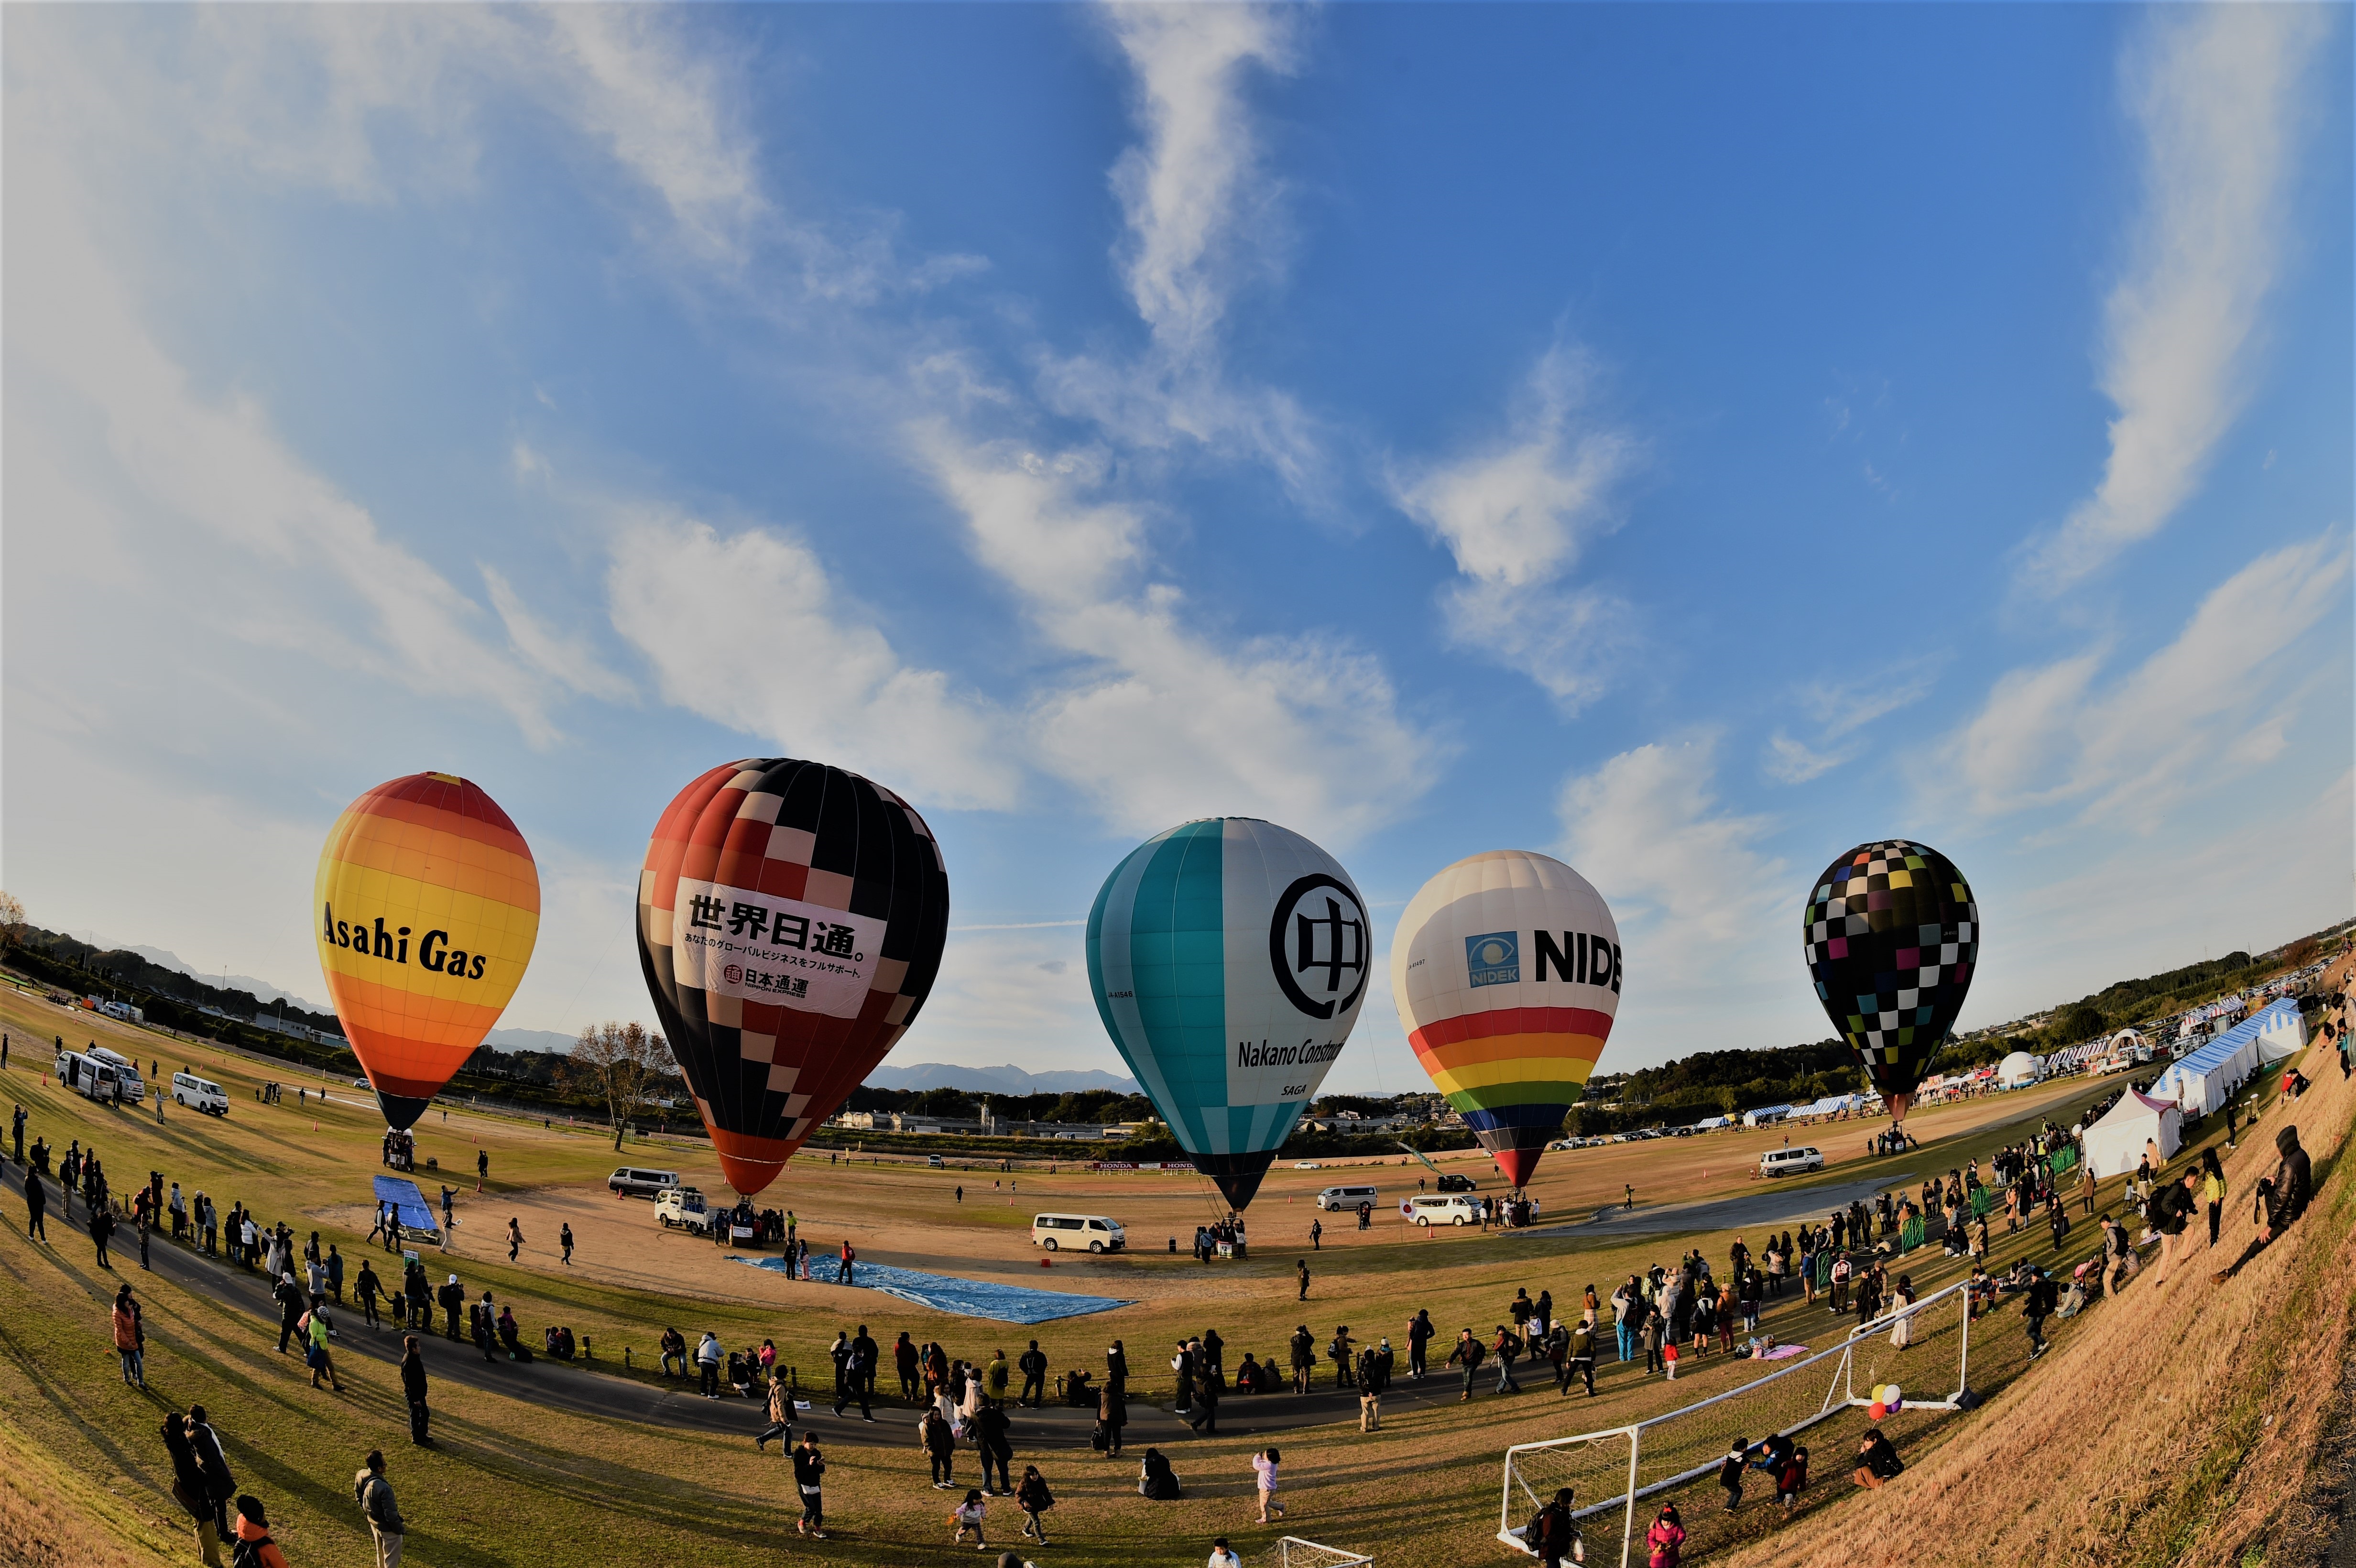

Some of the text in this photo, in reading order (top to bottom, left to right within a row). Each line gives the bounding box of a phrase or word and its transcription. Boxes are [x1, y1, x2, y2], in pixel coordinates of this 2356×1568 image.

[323, 902, 486, 979] Asahi Gas
[689, 894, 864, 963] 世界日通。
[685, 933, 862, 979] あなたのグローバルビジネスをフルサポート。
[745, 968, 809, 994] 日本通運
[745, 982, 806, 999] NIPPON EXPRESS
[1471, 969, 1518, 985] NIDEK
[1238, 1039, 1297, 1067] Nakano
[1281, 1084, 1307, 1096] SAGA
